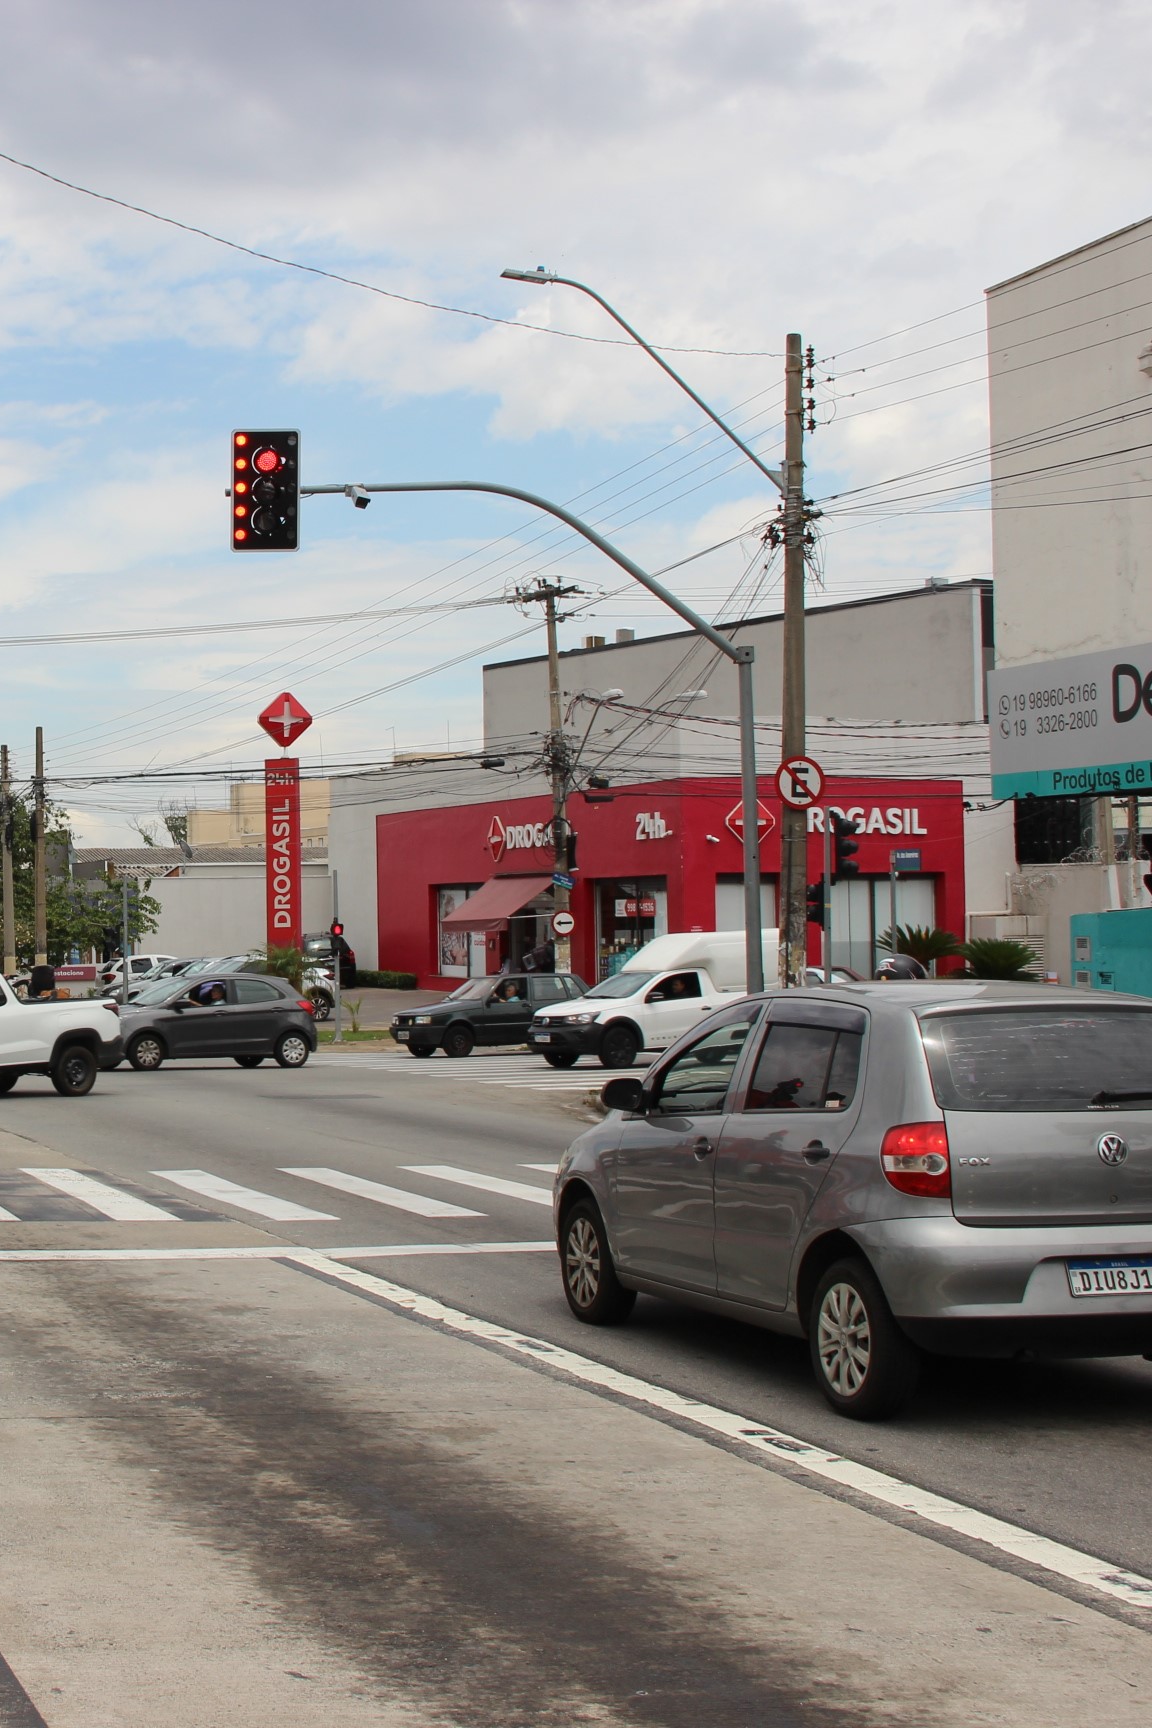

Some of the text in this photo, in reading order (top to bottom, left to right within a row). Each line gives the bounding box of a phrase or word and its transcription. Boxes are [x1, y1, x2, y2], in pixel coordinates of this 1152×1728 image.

[1013, 683, 1097, 711] 19 98960-6166
[1013, 709, 1098, 736] 19 3326-2800
[1053, 768, 1120, 790] Produtos
[1125, 764, 1145, 783] de
[636, 812, 666, 840] 24h
[272, 799, 291, 928] DROGASIL
[959, 1157, 991, 1166] FOX
